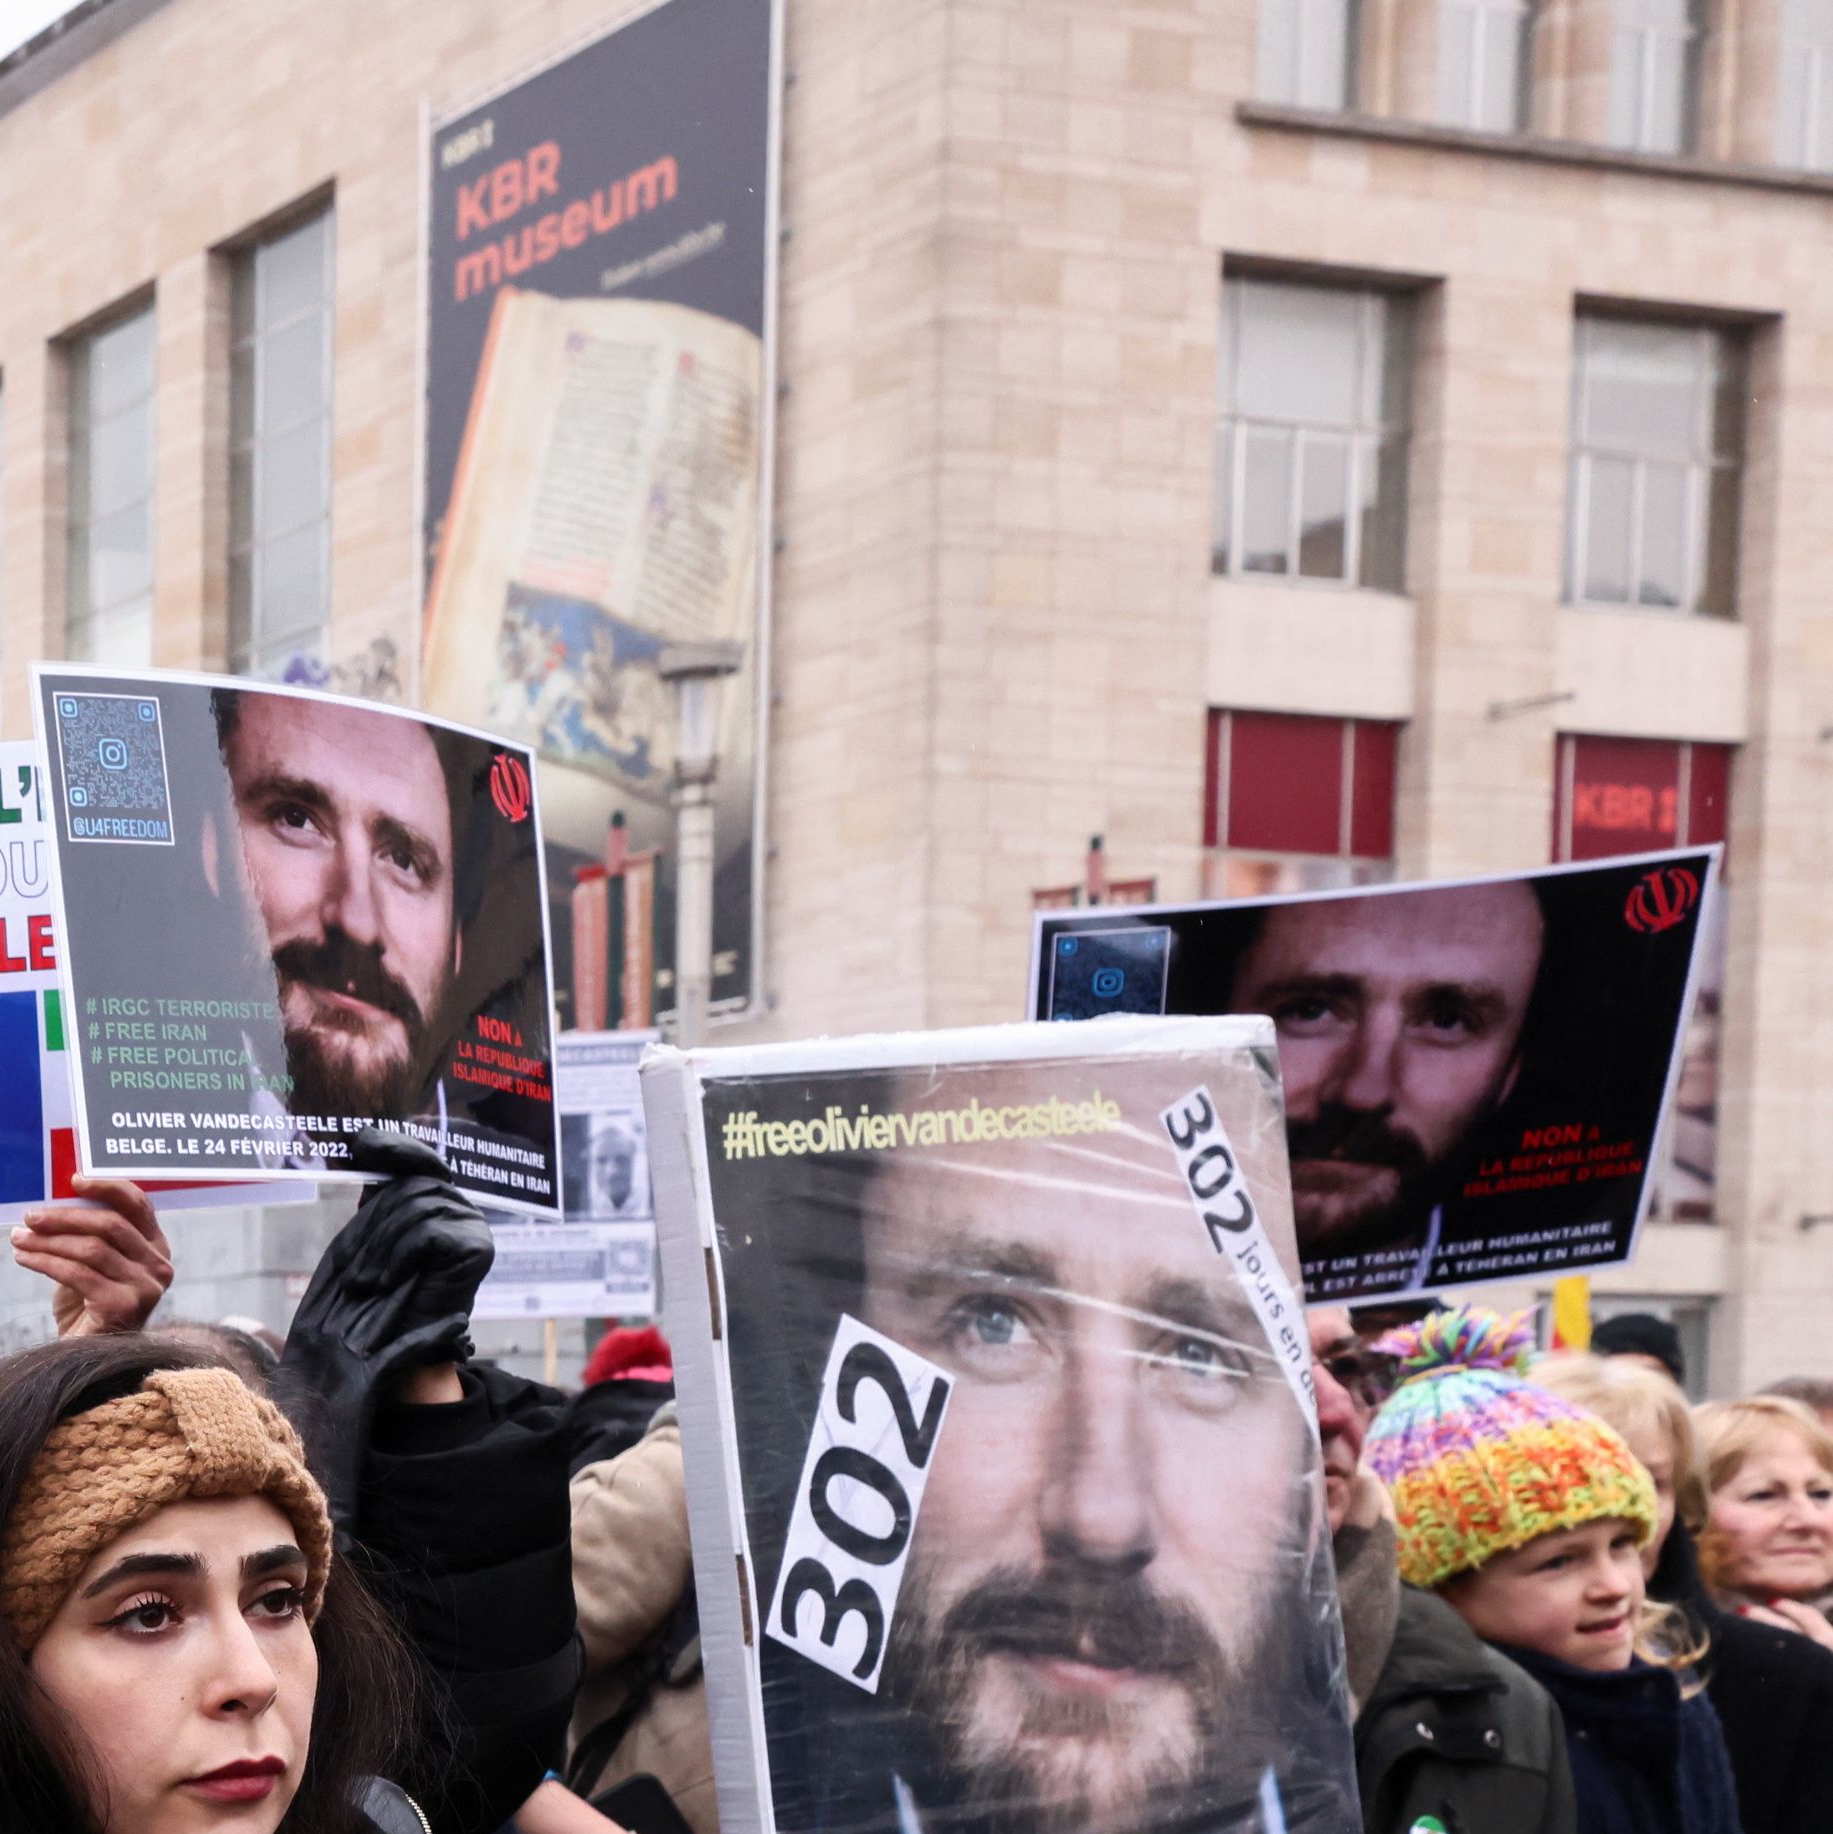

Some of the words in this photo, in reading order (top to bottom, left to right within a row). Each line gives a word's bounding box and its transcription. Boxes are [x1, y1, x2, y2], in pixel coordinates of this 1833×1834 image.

[453, 155, 678, 302] museum
[455, 139, 562, 241] KBR
[477, 1014, 512, 1044] NON
[105, 1138, 172, 1154] BELGE.
[176, 1138, 199, 1154] LE
[204, 1139, 226, 1155] 24
[111, 1112, 186, 1128] OLIVIER
[190, 1113, 338, 1132] VANDECASTEELE
[477, 1138, 546, 1169] HUMANITAIRE
[1521, 1123, 1583, 1149] NON
[1166, 1092, 1254, 1255] 302
[1236, 1240, 1285, 1320] jours
[1279, 1328, 1303, 1362] en
[779, 1339, 948, 1681] 302
